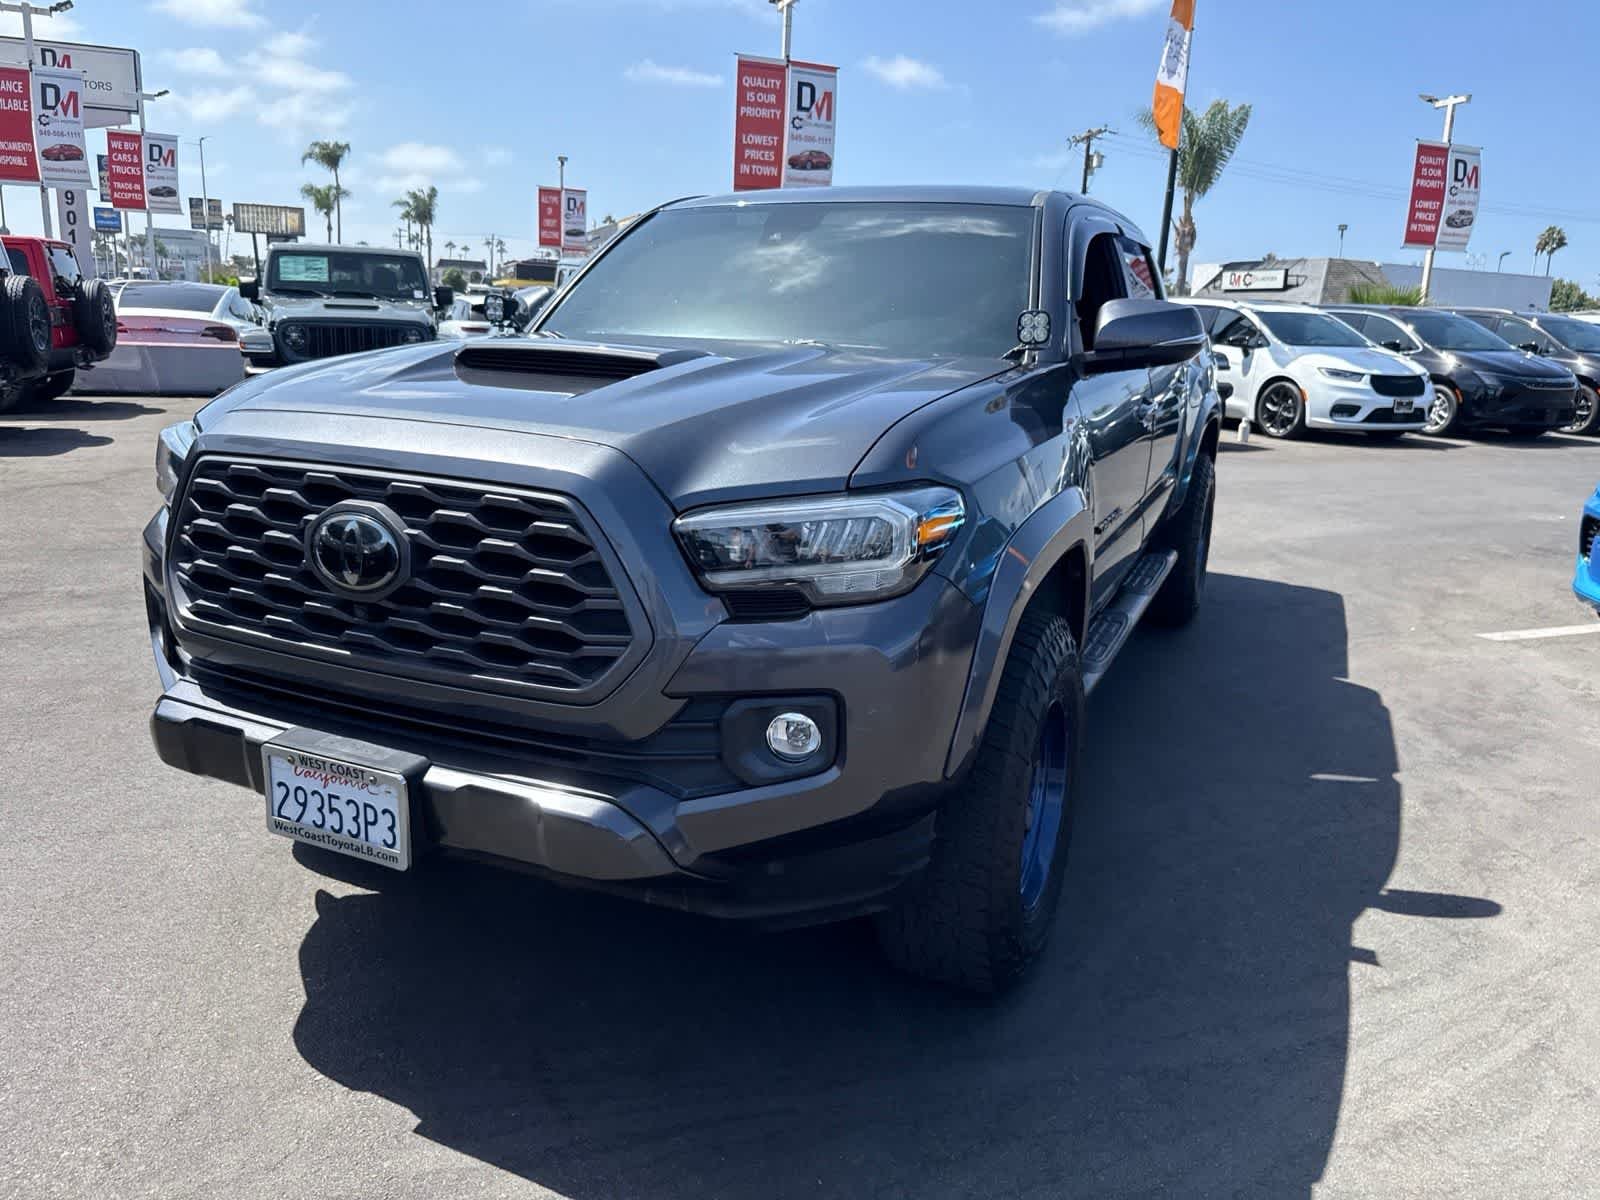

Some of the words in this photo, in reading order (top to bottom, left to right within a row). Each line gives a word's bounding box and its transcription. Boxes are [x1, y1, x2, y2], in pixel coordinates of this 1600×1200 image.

[0, 80, 24, 94] ANCE
[742, 75, 781, 89] QUALITY
[746, 92, 756, 102] IS
[756, 92, 776, 104] OUR
[740, 106, 781, 120] PRIORITY
[110, 140, 122, 149] WE
[123, 141, 139, 151] BUY
[742, 134, 778, 146] LOWEST
[112, 153, 132, 162] CARS
[132, 154, 139, 163] &
[744, 149, 775, 161] PRICES
[1419, 155, 1446, 165] QUALITY
[111, 165, 141, 176] TRUCKS
[740, 164, 750, 175] IN
[750, 165, 778, 177] TOWN
[1421, 168, 1428, 176] IS
[1428, 168, 1442, 177] OUR
[113, 181, 141, 191] TRADE-IN
[1415, 179, 1444, 190] PRIORITY
[113, 191, 142, 201] ACCEPTED
[1415, 200, 1440, 210] LOWEST
[1414, 211, 1436, 221] PRICES
[1410, 223, 1418, 232] IN
[1417, 224, 1436, 233] TOWN
[298, 755, 327, 770] WEST
[330, 763, 366, 780] COAST
[276, 781, 397, 849] 29353P3
[274, 820, 399, 864] WestCoastToyotaLB.com
